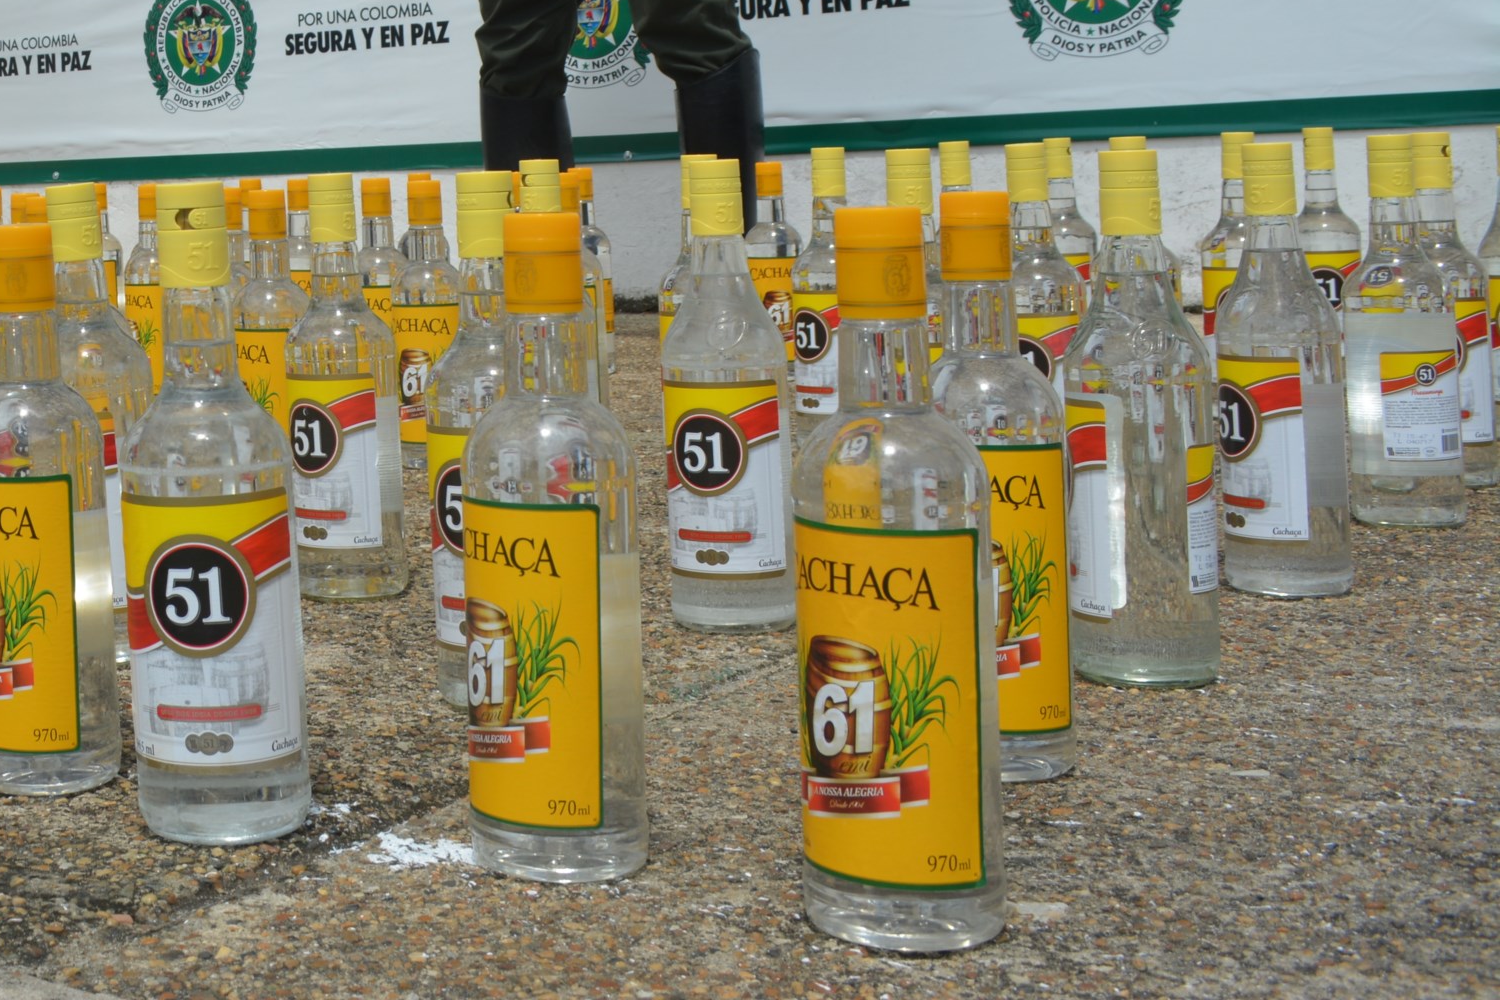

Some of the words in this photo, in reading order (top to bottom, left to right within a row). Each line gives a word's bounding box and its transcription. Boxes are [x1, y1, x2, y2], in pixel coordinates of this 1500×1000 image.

[297, 12, 324, 28] POR
[326, 8, 358, 25] UNA
[359, 1, 434, 22] COLOMBIA
[20, 33, 79, 51] COLOMBIA
[284, 28, 358, 56] SEGURA
[360, 26, 375, 50] Y
[380, 24, 405, 49] EN
[410, 20, 450, 46] PAZ
[21, 54, 33, 76] Y
[36, 52, 57, 75] EN
[60, 49, 92, 73] PAZ
[797, 322, 820, 351] 51
[402, 363, 427, 397] 61
[1419, 369, 1433, 381] 51
[1219, 401, 1246, 441] 51
[293, 420, 328, 460] 51
[684, 432, 728, 474] 51
[1272, 527, 1302, 538] Cachaça
[165, 566, 233, 626] 51
[796, 554, 941, 612] ACHAÇA
[1081, 599, 1106, 613] Cachaça
[468, 639, 505, 707] 61
[812, 680, 875, 757] 61
[272, 736, 299, 752] Cachaça
[820, 786, 843, 797] NOSSA
[843, 786, 884, 798] ALEGRIA
